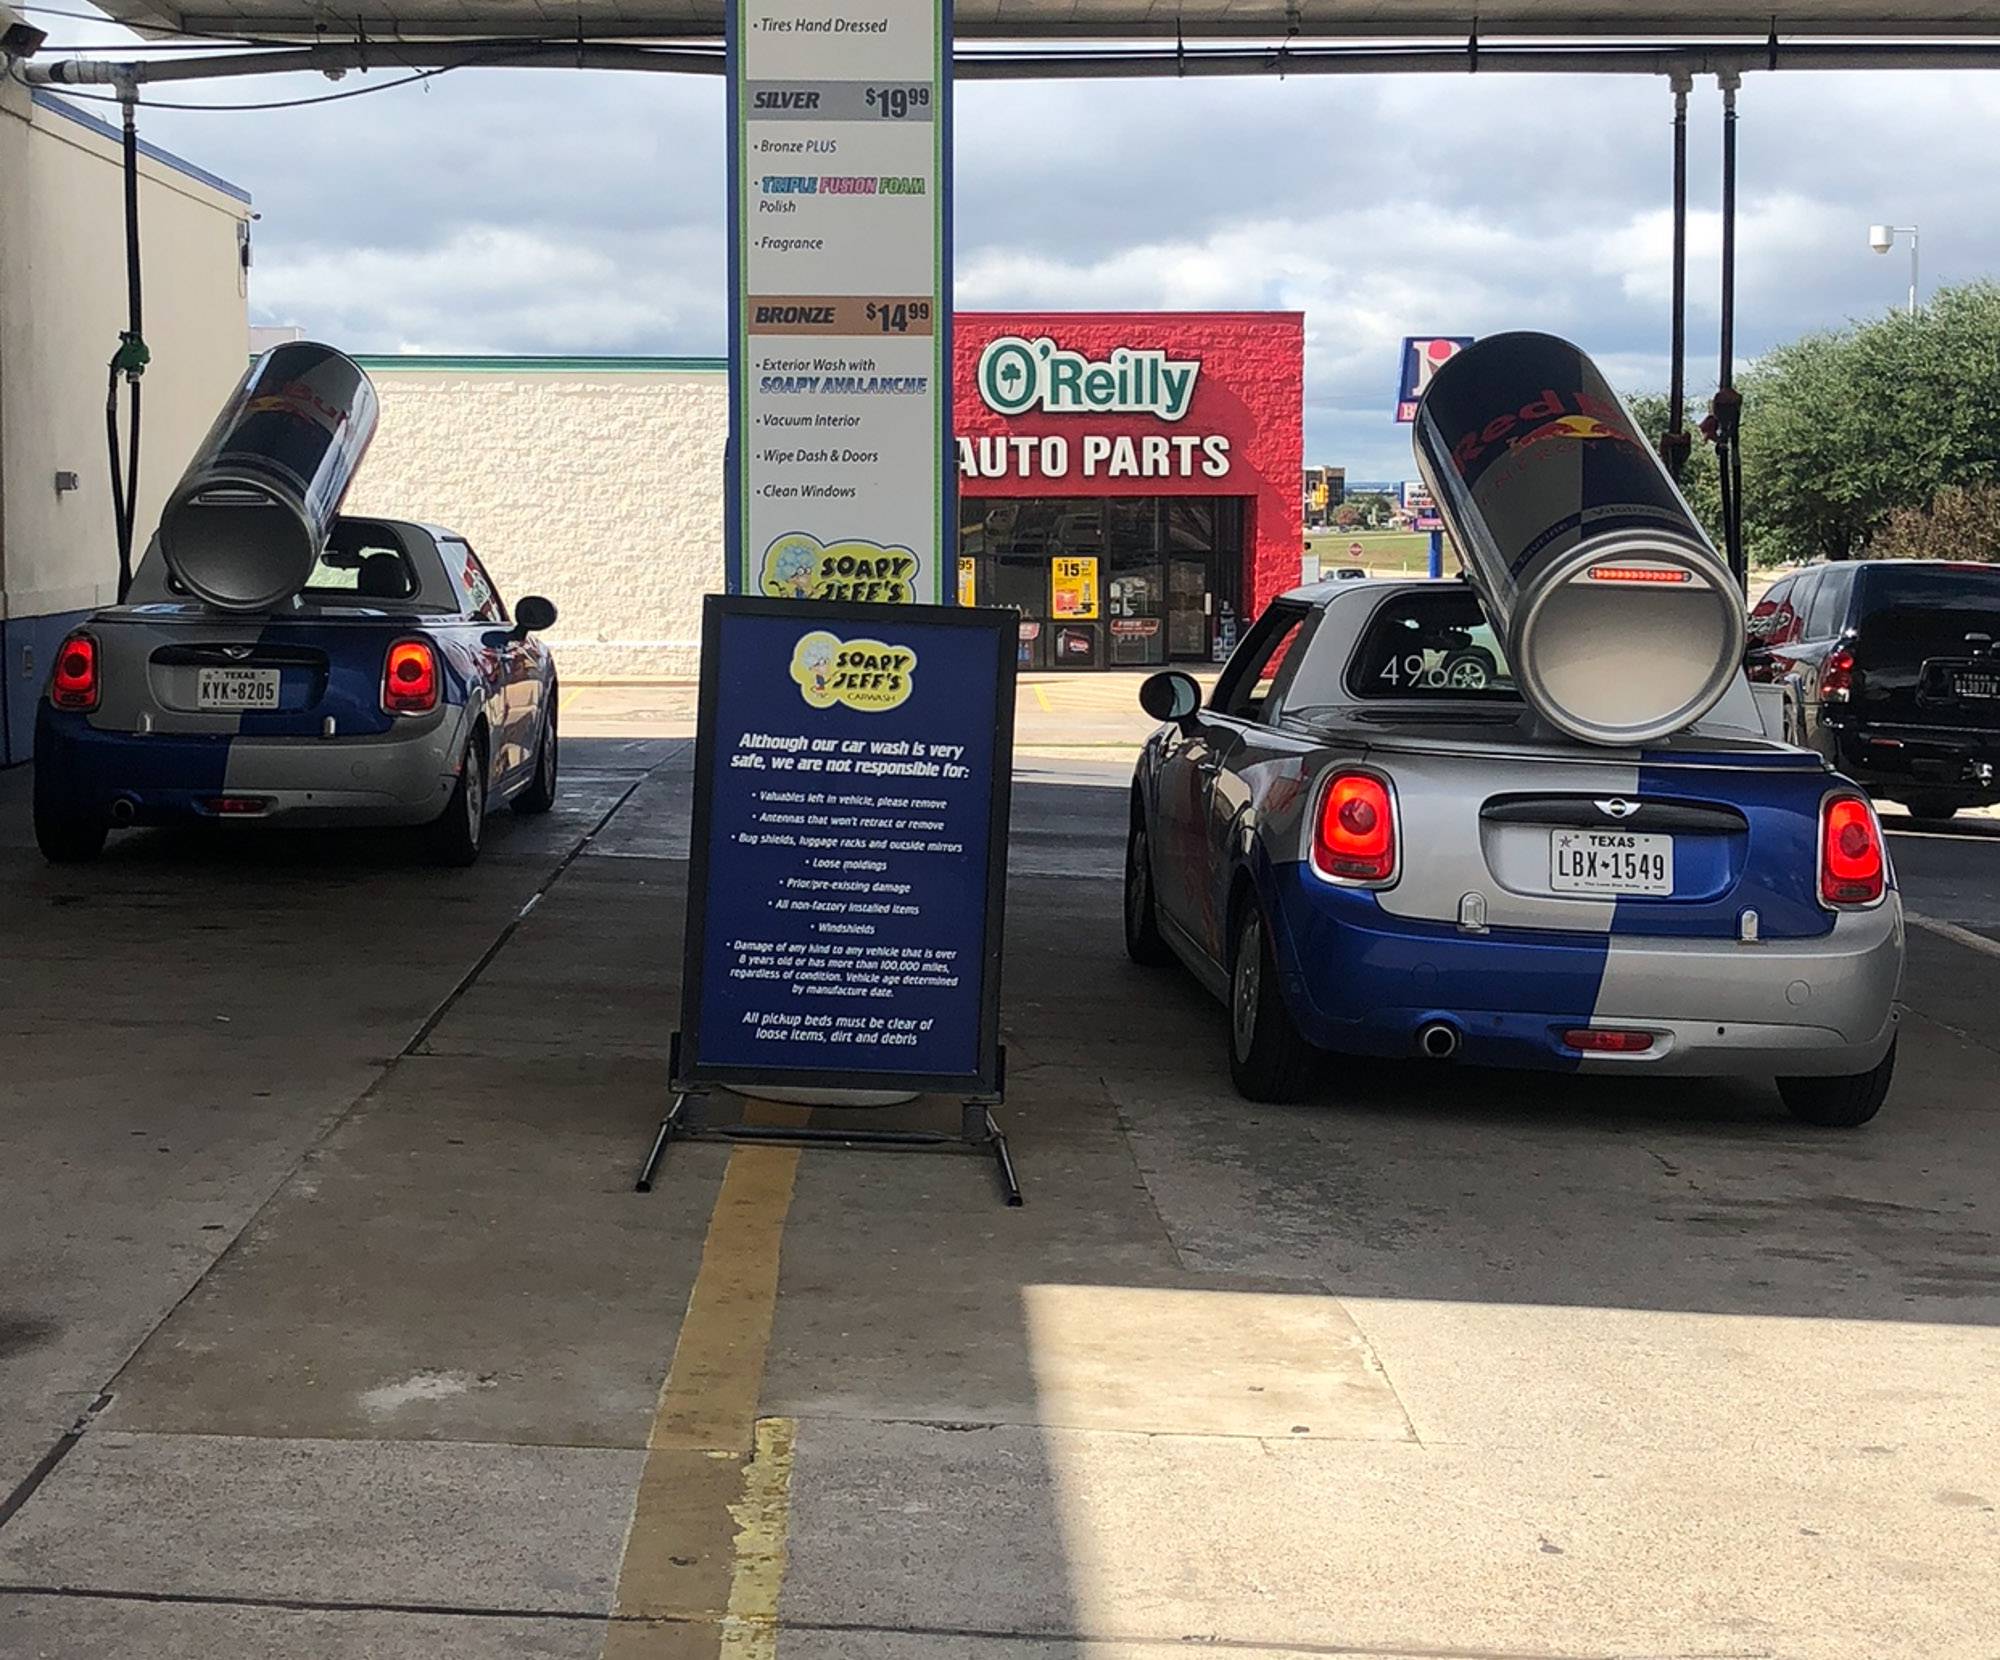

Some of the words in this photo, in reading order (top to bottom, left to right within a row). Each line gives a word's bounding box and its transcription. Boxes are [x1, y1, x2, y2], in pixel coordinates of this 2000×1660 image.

[762, 19, 791, 32] Tires
[795, 19, 831, 32] Hand
[834, 20, 887, 32] Dressed
[754, 92, 820, 109] SILVER
[761, 140, 803, 153] Bronze
[806, 141, 836, 152] PLUS
[762, 177, 817, 194] TRIPLE
[820, 177, 877, 194] FUSION
[879, 178, 925, 195] FOAM
[759, 201, 796, 213] Polish
[762, 237, 823, 251] Fragrance
[756, 307, 835, 323] BRONZE
[763, 359, 812, 371] Exterior
[814, 359, 845, 371] Wash
[848, 360, 875, 371] with
[985, 341, 1193, 413] O'Reilly
[760, 377, 819, 393] SOAPY
[823, 377, 928, 395] AVALANCHE
[763, 415, 812, 426] Vacuum
[815, 416, 860, 427] Interior
[763, 450, 793, 465] Wipe
[797, 450, 828, 462] Dash
[831, 451, 839, 461] &
[842, 451, 878, 462] Doors
[958, 436, 1067, 477] AUTO
[1083, 436, 1230, 477] PARTS
[763, 485, 797, 497] Clean
[801, 485, 855, 498] Windows
[821, 556, 911, 579] SOAPY
[819, 582, 904, 603] JEFF'S
[836, 651, 910, 670] SOAPY
[833, 672, 902, 690] JEFF'S
[847, 693, 896, 701] CARWASH
[739, 733, 808, 751] Although
[811, 740, 836, 751] our
[842, 740, 865, 753] car
[870, 740, 909, 755] wash
[912, 742, 925, 755] is
[929, 744, 963, 759] very
[731, 754, 766, 770] safe,
[772, 757, 794, 769] we
[798, 758, 821, 771] are
[826, 759, 851, 771] not
[855, 760, 939, 777] responsible
[943, 763, 969, 778] for:
[760, 791, 805, 802] Valuables
[808, 793, 824, 803] left
[827, 794, 836, 803] in
[877, 796, 908, 808] please
[911, 799, 947, 809] remove
[760, 813, 804, 824] Antennas
[808, 814, 827, 825] that
[831, 816, 857, 826] won't
[860, 817, 893, 828] retract
[895, 819, 905, 829] or
[909, 820, 944, 830] remove
[739, 833, 758, 846] Bug
[761, 834, 796, 846] shields,
[799, 836, 838, 849] luggage
[840, 838, 866, 848] racks
[869, 839, 887, 849] and
[890, 840, 925, 851] outside
[928, 842, 963, 852] mirrors
[1589, 836, 1635, 847] TEXAS
[813, 858, 840, 869] Loose
[844, 860, 886, 872] moldings
[872, 882, 911, 894] damage
[776, 900, 789, 909] All
[791, 901, 845, 913] non-factory
[849, 903, 890, 914] installed
[893, 905, 919, 915] items
[819, 923, 874, 935] Windshields
[734, 940, 774, 953] Damage
[776, 941, 787, 952] of
[789, 943, 806, 954] any
[809, 944, 830, 954] kind
[832, 945, 843, 954] to
[845, 946, 863, 957] any
[866, 946, 899, 957] vehicle
[902, 947, 922, 958] that
[925, 949, 933, 958] is
[935, 950, 956, 959] over
[739, 954, 746, 964] 8
[749, 955, 774, 966] years
[777, 955, 793, 966] old
[796, 957, 806, 967] or
[809, 957, 825, 968] has
[828, 958, 853, 969] more
[856, 959, 878, 970] than
[730, 968, 780, 980] regardless
[784, 970, 793, 980] of
[795, 970, 842, 982] condition.
[846, 972, 879, 983] Vehicle
[882, 974, 900, 985] age
[902, 974, 958, 986] determined
[792, 984, 804, 995] by
[807, 985, 867, 997] manufacture
[871, 987, 894, 998] date.
[743, 1012, 759, 1023] All
[762, 1013, 800, 1027] pickup
[805, 1015, 832, 1026] beds
[835, 1016, 866, 1028] must
[869, 1017, 884, 1029] be
[888, 1018, 917, 1030] clear
[920, 1019, 933, 1031] of
[756, 1028, 787, 1040] loose
[791, 1029, 826, 1043] items,
[831, 1031, 852, 1043] dirt
[856, 1032, 878, 1044] and
[882, 1032, 917, 1045] debris
